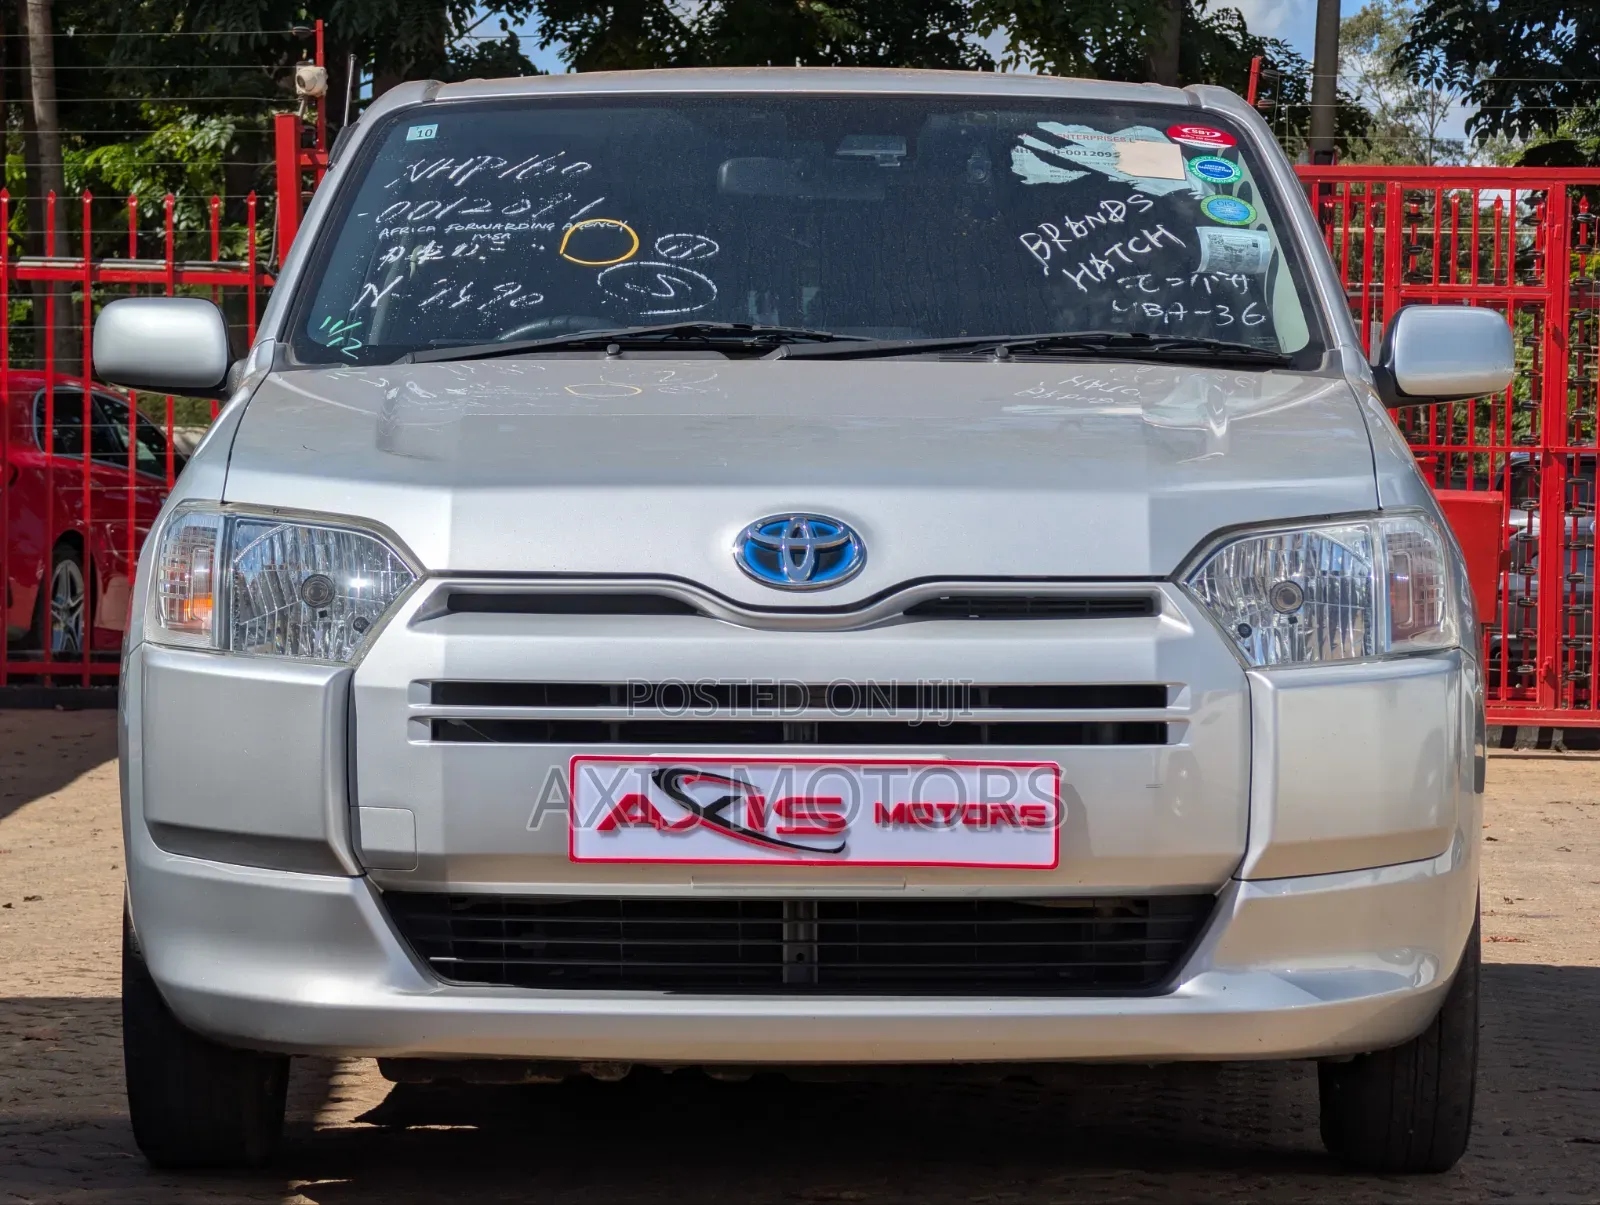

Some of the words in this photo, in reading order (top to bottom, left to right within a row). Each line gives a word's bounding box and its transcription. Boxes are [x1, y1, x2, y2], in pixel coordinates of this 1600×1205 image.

[417, 129, 433, 138] 10
[378, 224, 436, 240] AFRICA
[444, 221, 555, 232] FORWARDING
[1062, 224, 1187, 293] HATCH
[875, 802, 1057, 828] MOTORS
